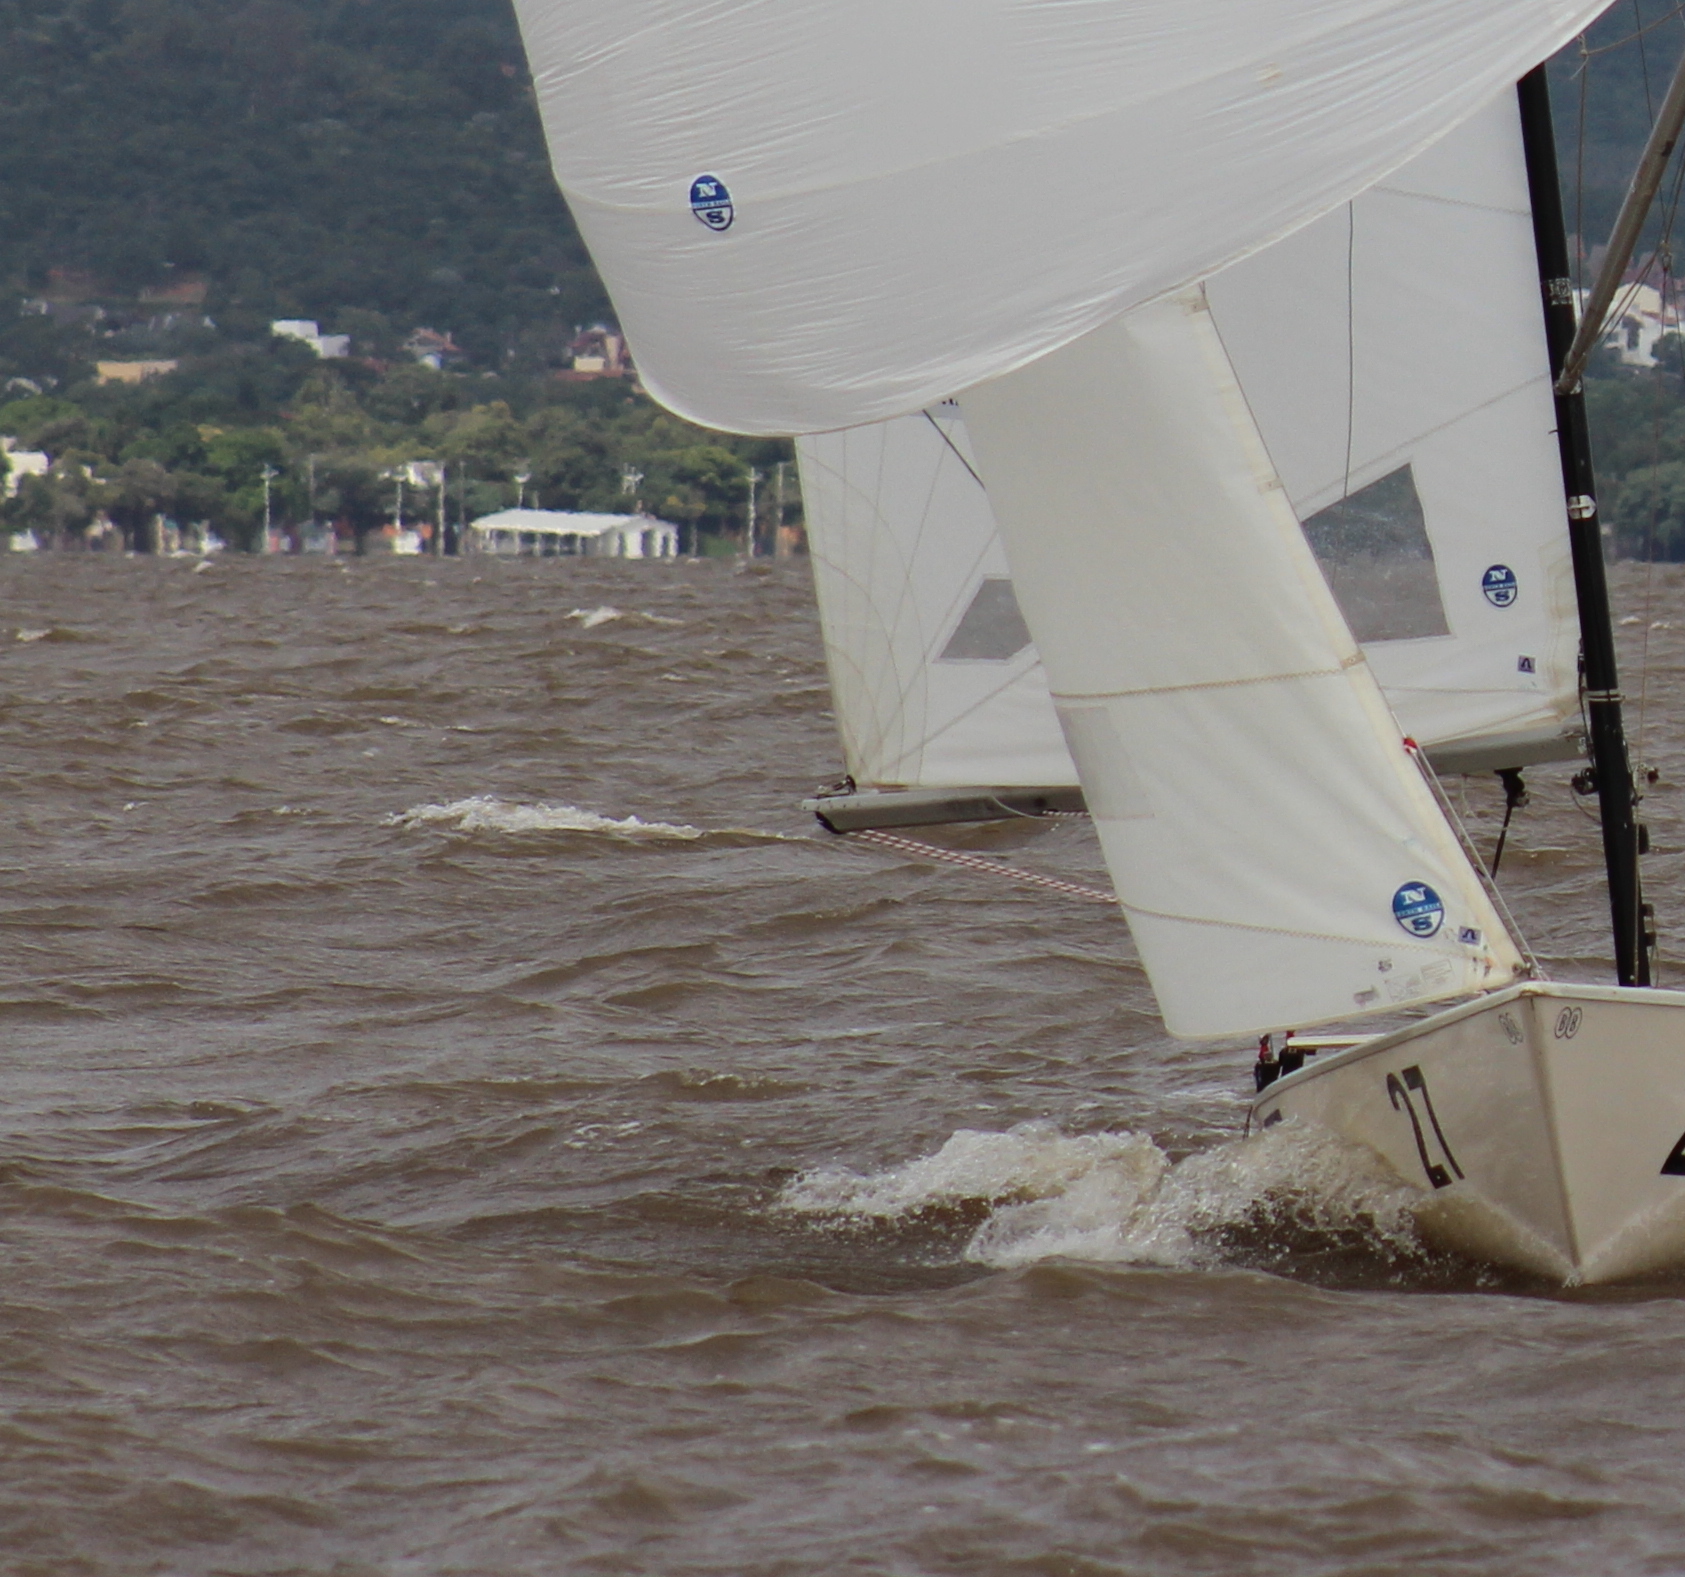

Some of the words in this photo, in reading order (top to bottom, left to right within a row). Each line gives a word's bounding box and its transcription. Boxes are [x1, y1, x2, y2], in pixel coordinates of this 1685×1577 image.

[696, 182, 717, 197] N
[706, 210, 725, 224] S
[1489, 569, 1508, 582] N
[1494, 590, 1510, 602] S
[1400, 887, 1427, 906] N
[1411, 915, 1433, 932] S
[1386, 1064, 1465, 1190] 27
